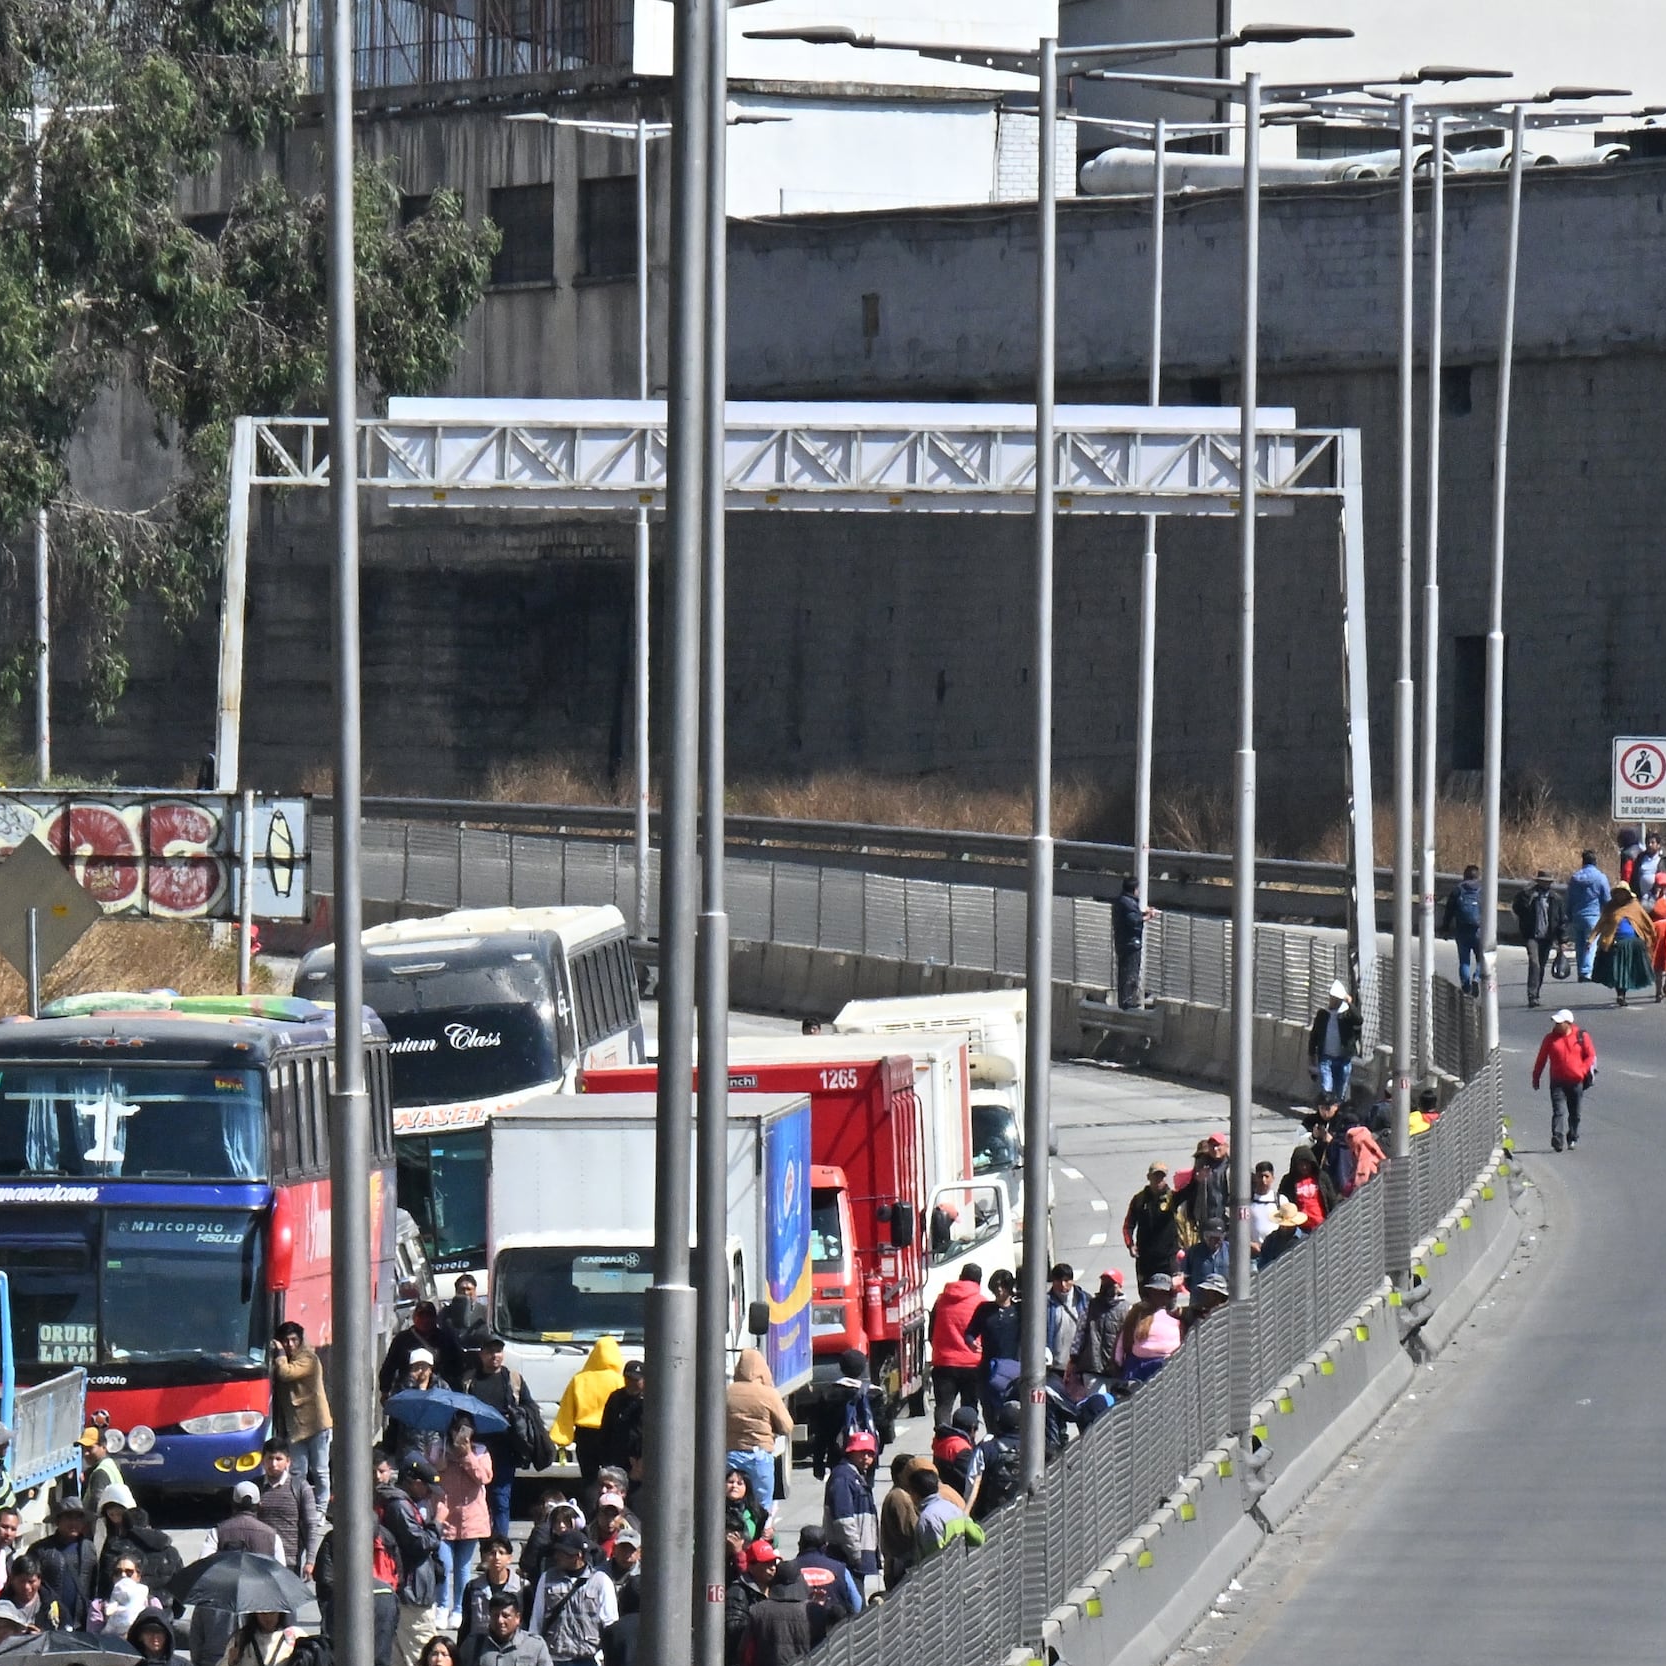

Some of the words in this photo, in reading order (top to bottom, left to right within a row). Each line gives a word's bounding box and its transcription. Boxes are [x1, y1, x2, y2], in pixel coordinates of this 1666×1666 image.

[1621, 806, 1629, 814] DE
[444, 1023, 501, 1050] Class
[820, 1068, 857, 1089] 1265
[131, 1220, 225, 1233] Marcopolo
[581, 1255, 624, 1264] CARMAX
[1032, 1389, 1044, 1403] 17
[709, 1585, 725, 1602] 16
